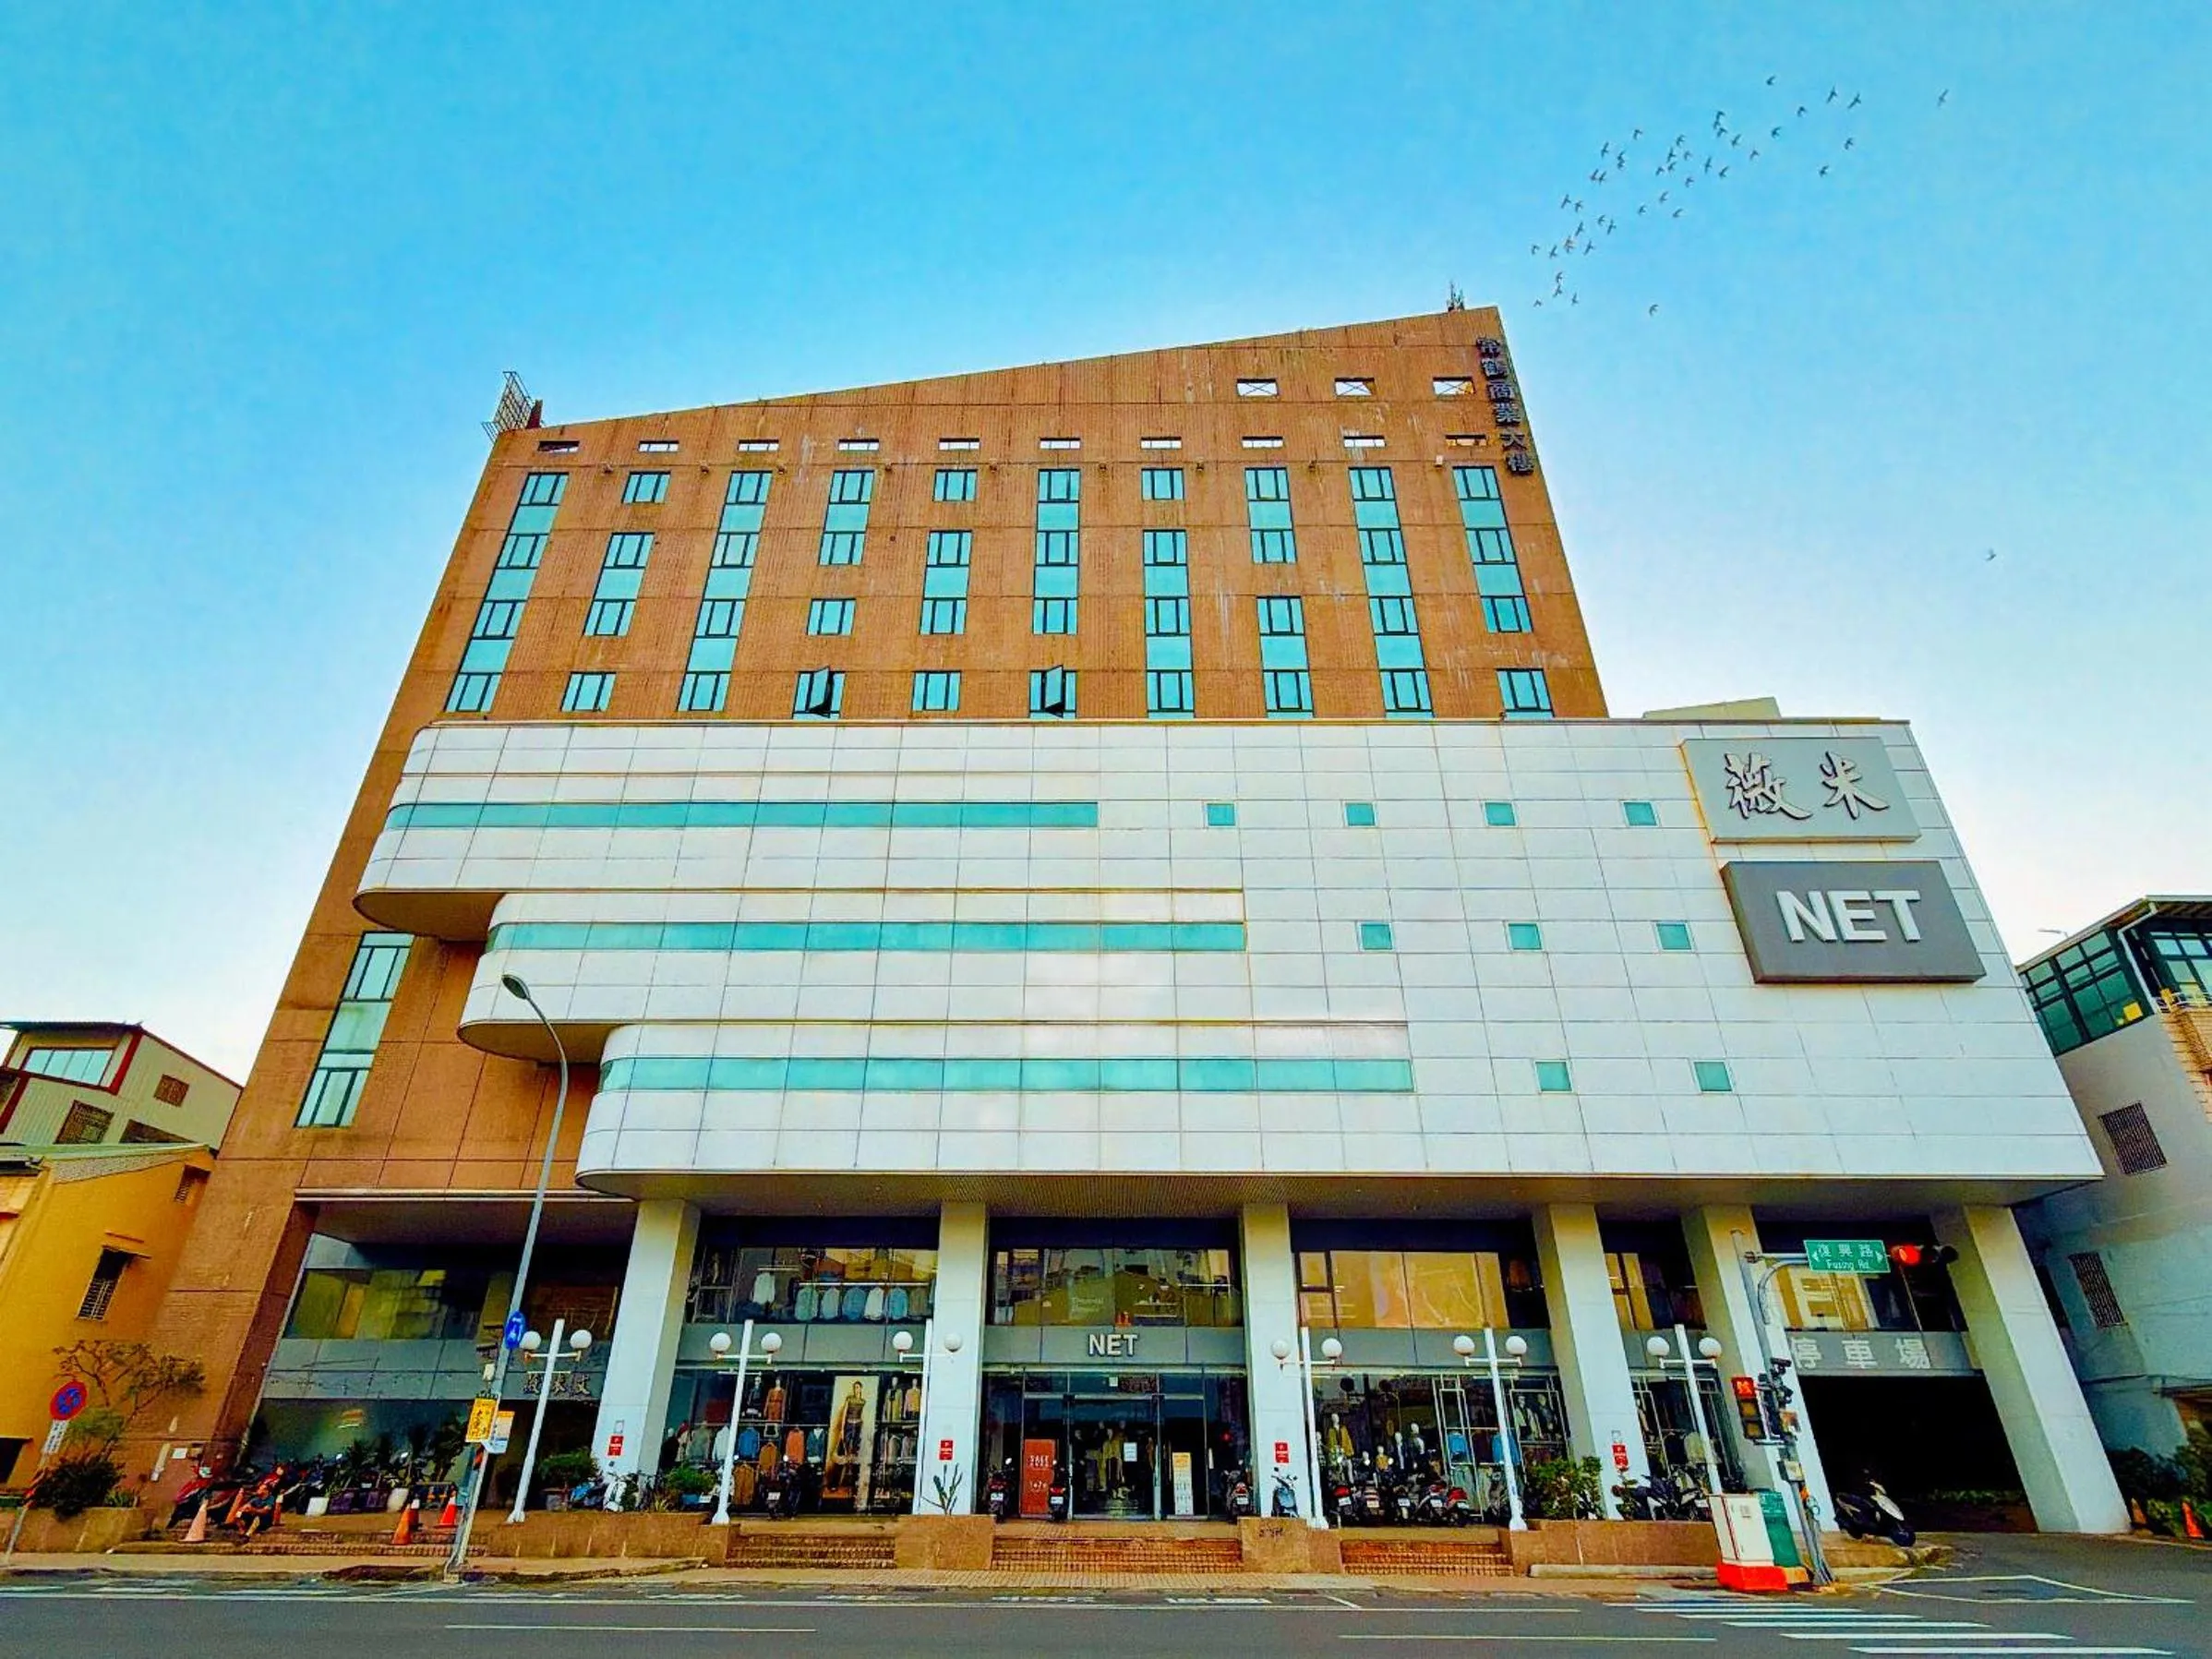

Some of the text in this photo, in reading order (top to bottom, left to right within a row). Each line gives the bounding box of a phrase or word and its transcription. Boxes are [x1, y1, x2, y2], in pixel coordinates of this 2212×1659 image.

[1776, 890, 1921, 943] NET
[1088, 1333, 1137, 1356] NET
[1791, 1337, 1931, 1369] 停車場
